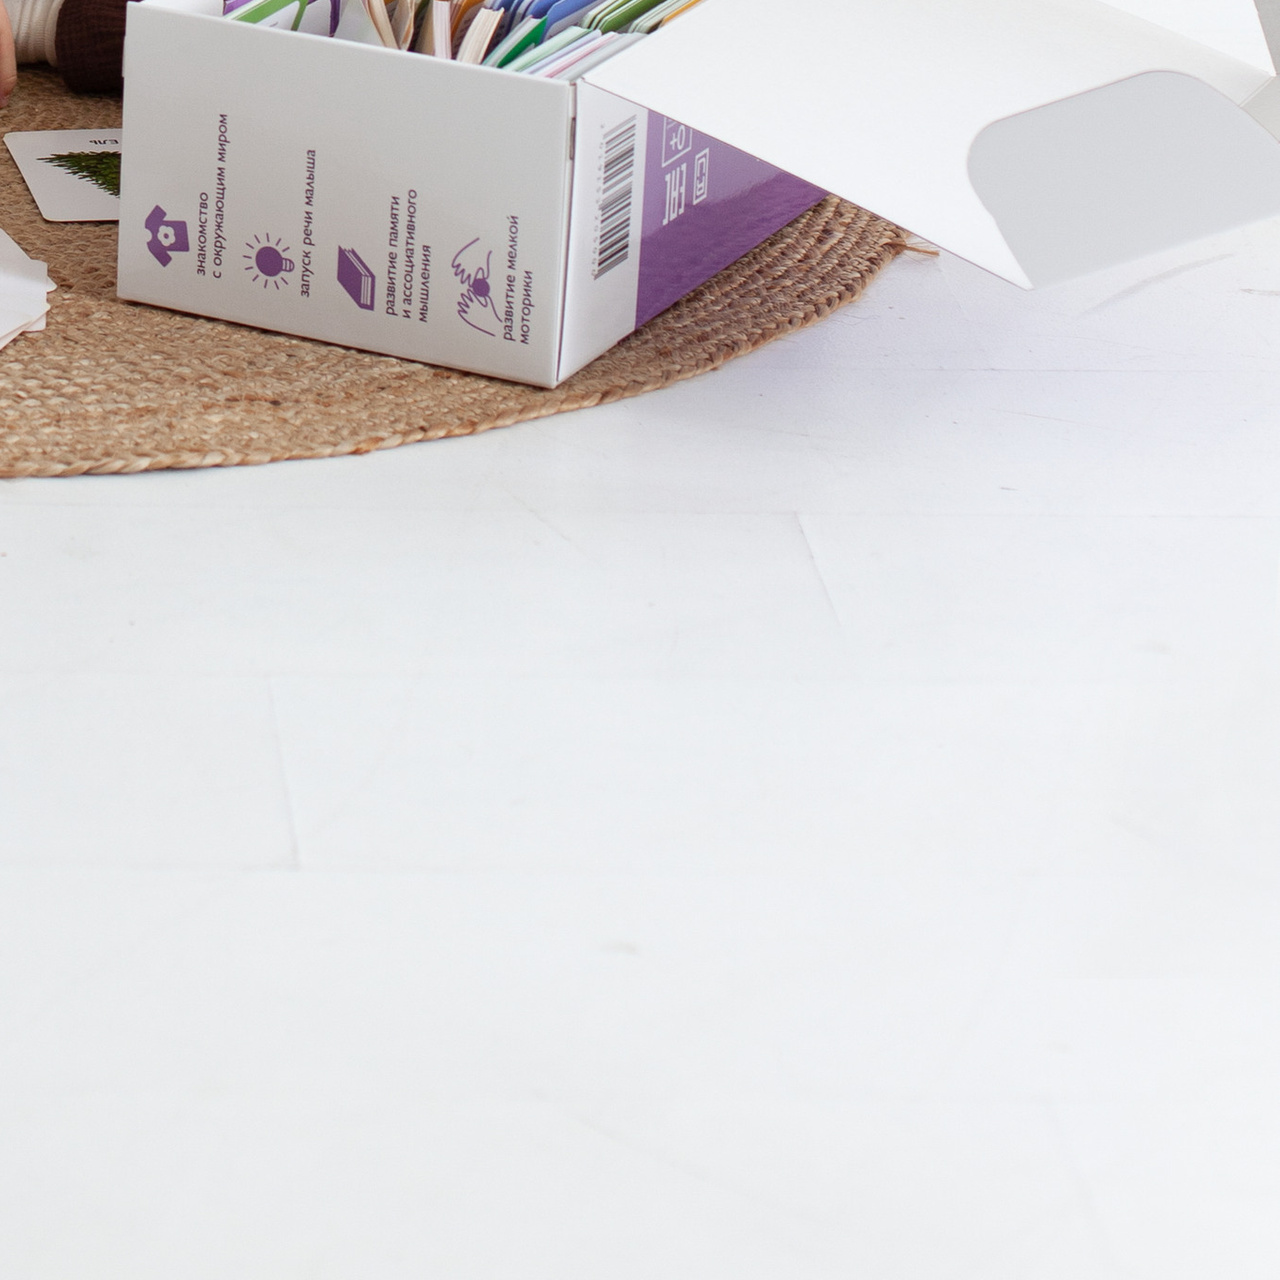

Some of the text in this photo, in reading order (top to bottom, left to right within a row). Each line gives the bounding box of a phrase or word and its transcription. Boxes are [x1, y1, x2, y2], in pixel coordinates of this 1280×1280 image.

[197, 192, 208, 276] знакомство
[213, 113, 231, 279] с окружающим миром
[300, 149, 316, 298] запуск речи малыша
[385, 196, 400, 316] развитие памяти
[402, 189, 418, 319] и ассоциативного
[418, 244, 431, 323] мышления
[503, 214, 519, 342] развитие мелкой
[520, 270, 535, 345] моторики
